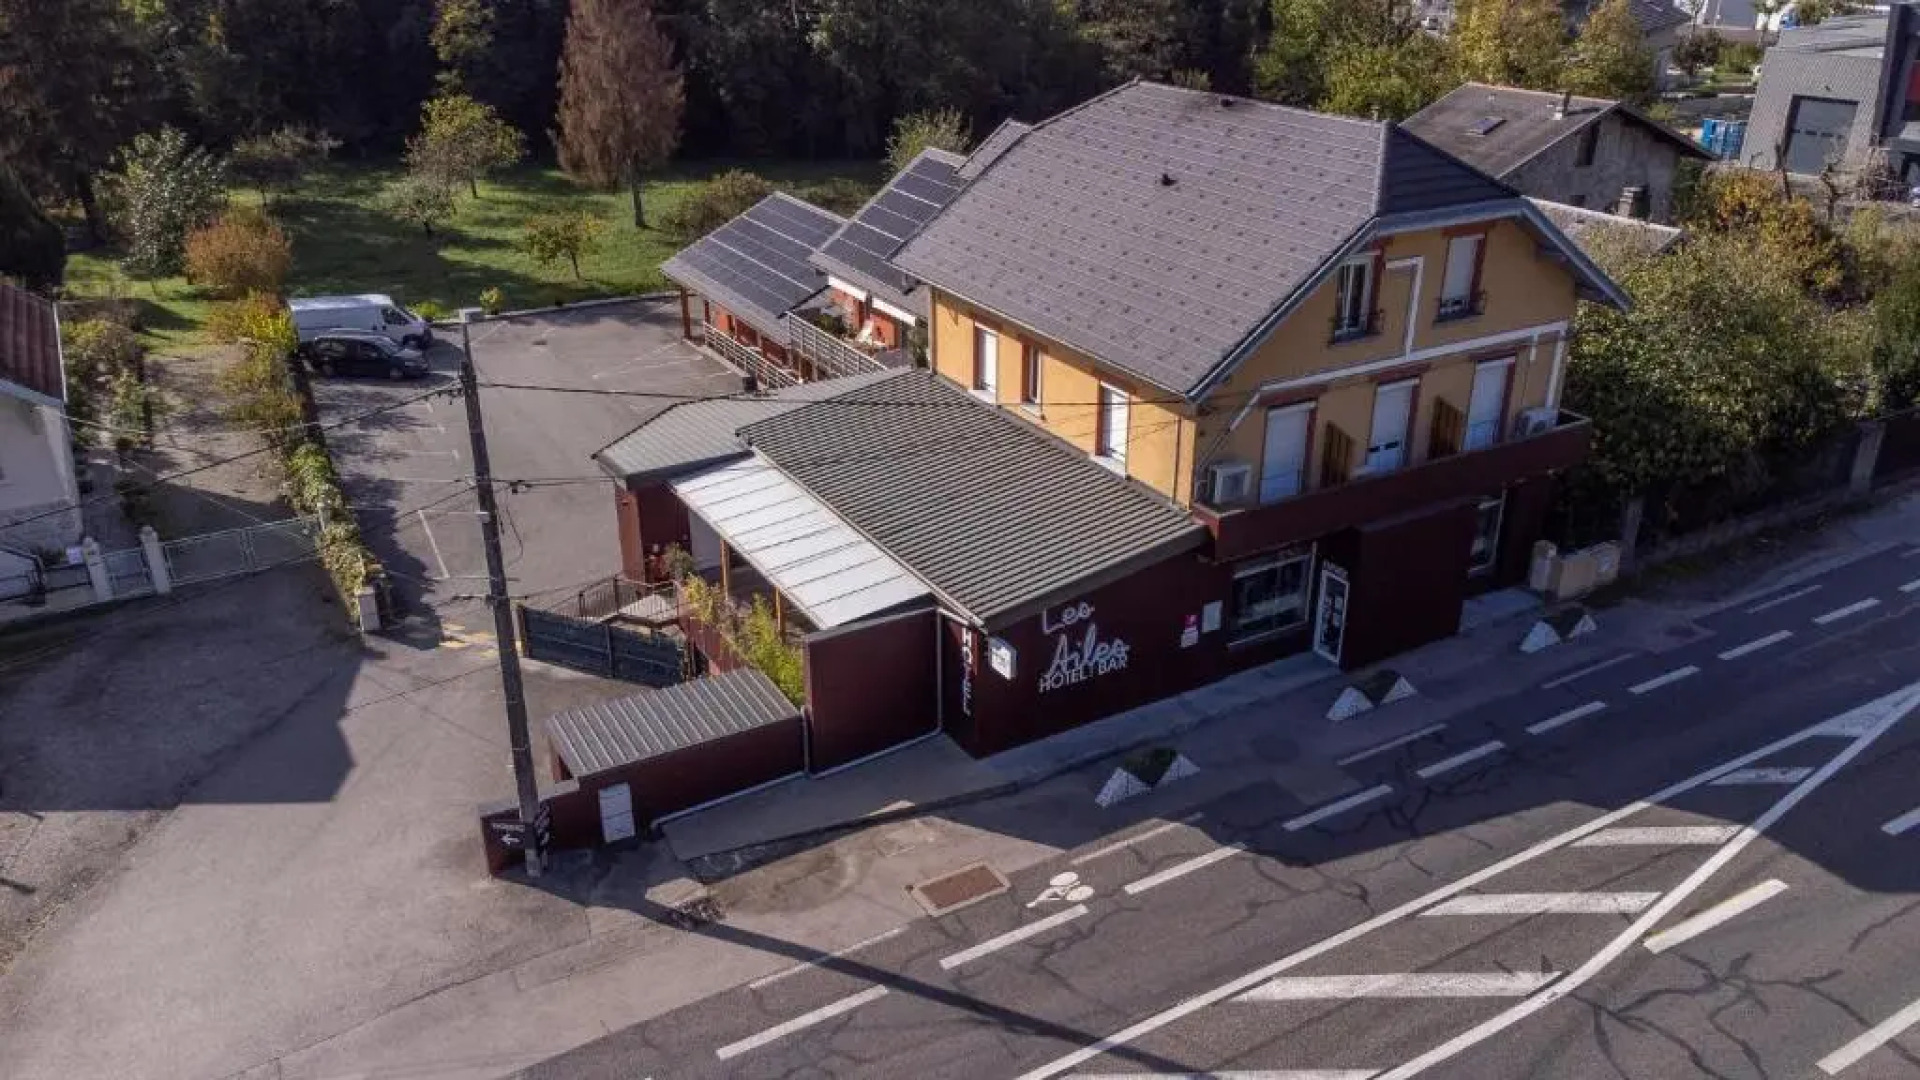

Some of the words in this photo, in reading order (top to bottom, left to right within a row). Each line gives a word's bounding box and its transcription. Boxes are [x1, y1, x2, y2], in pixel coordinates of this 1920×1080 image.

[1042, 601, 1096, 635] Les
[1048, 623, 1130, 665] Ailes
[1098, 654, 1128, 676] BAR
